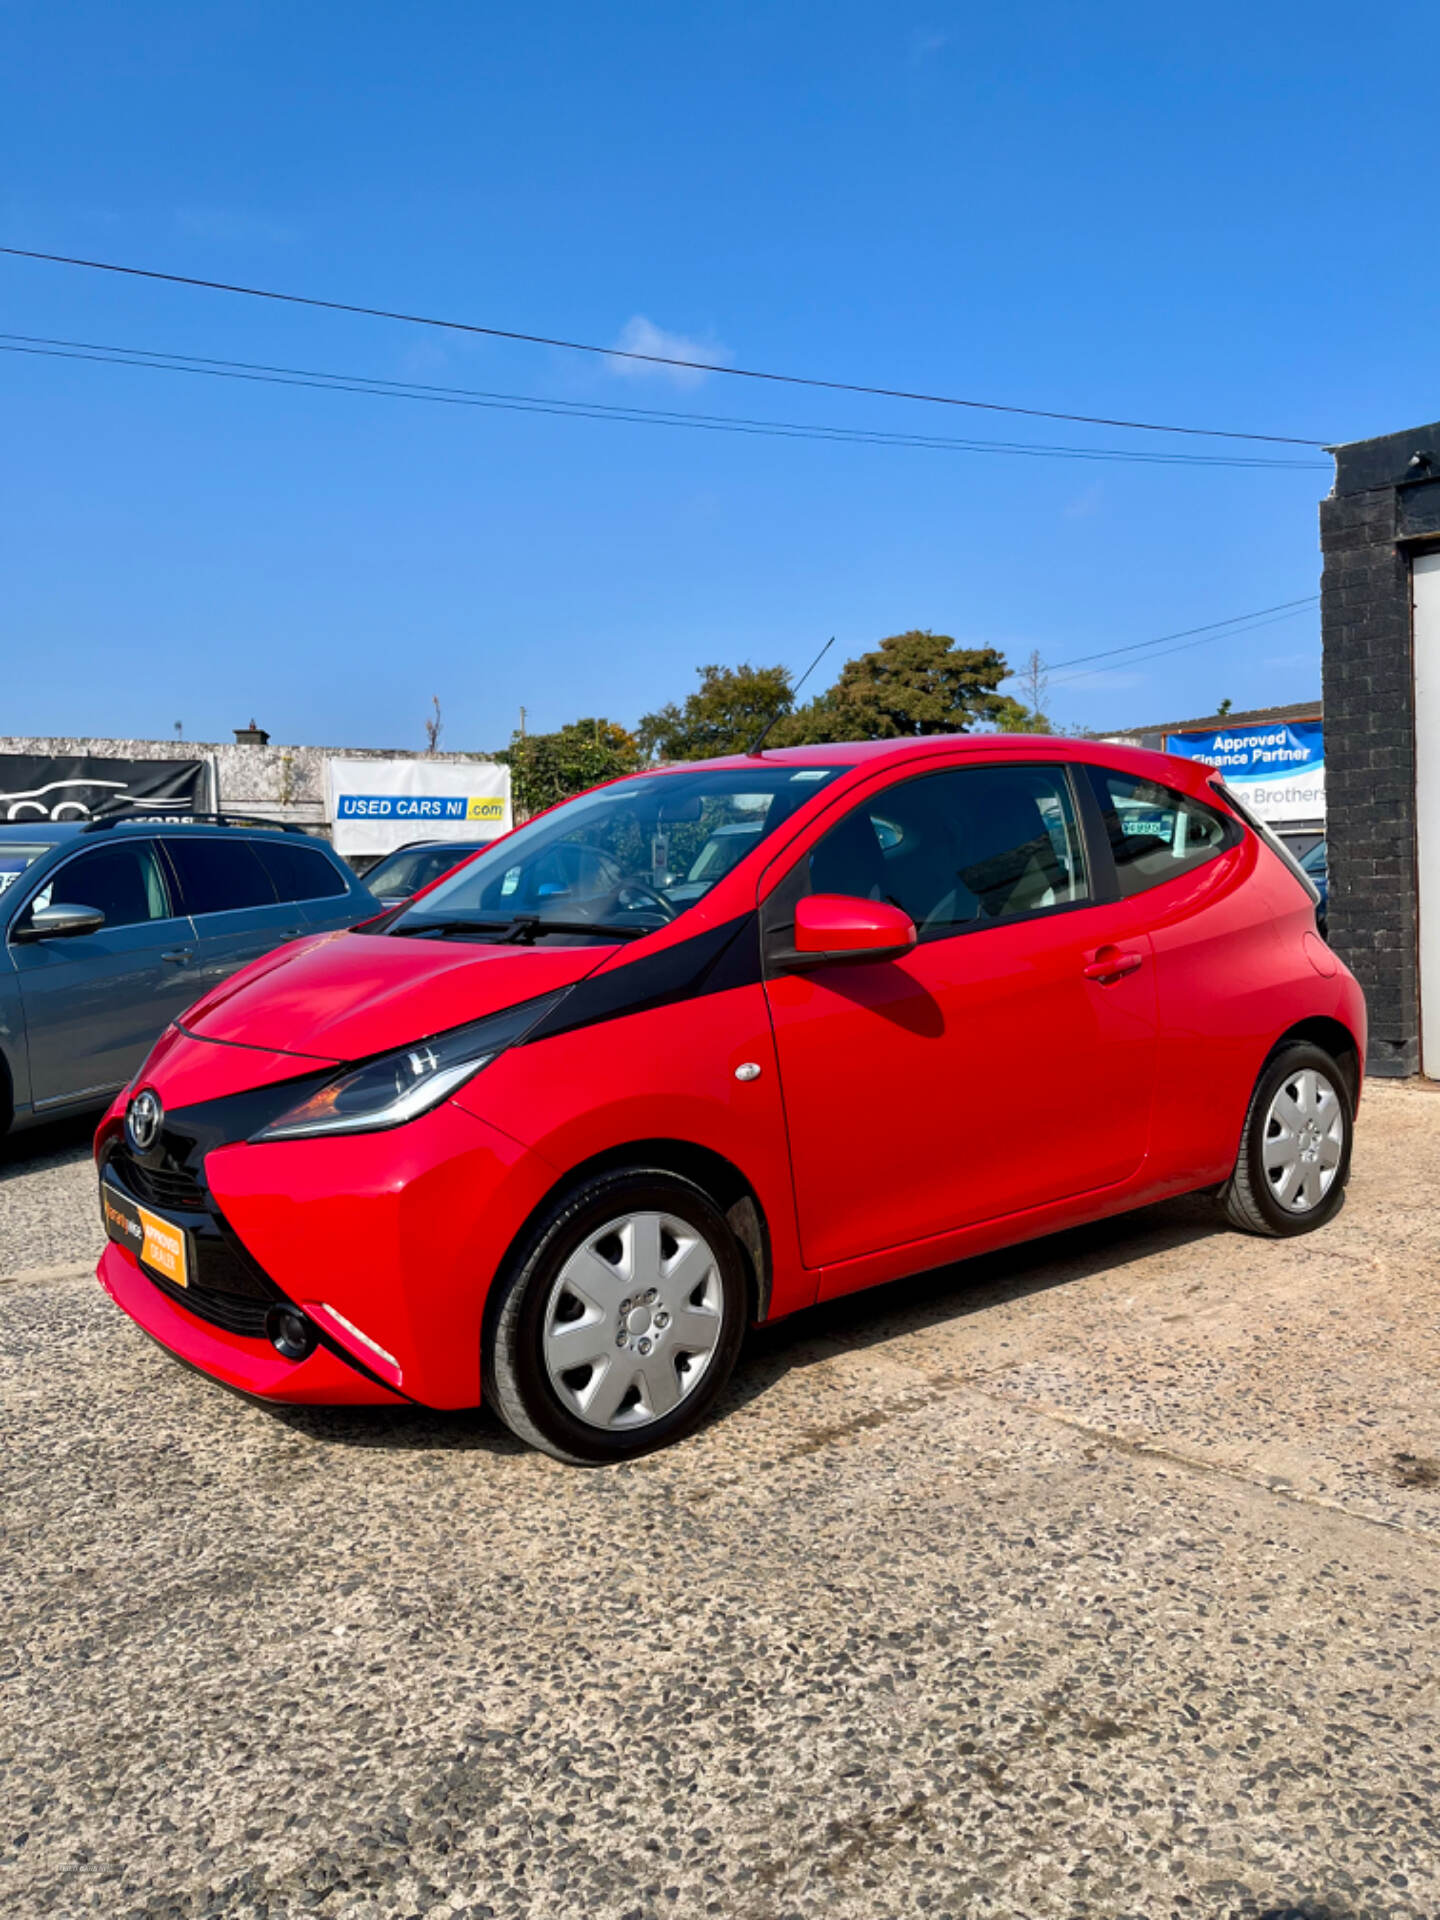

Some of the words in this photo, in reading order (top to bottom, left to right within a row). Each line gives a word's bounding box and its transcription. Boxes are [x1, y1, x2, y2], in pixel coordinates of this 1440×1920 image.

[1213, 730, 1286, 752] Approved
[1252, 748, 1311, 762] Partner
[344, 800, 391, 815] USED
[396, 800, 442, 815] CARS
[446, 801, 462, 815] NI
[468, 804, 503, 816] .com
